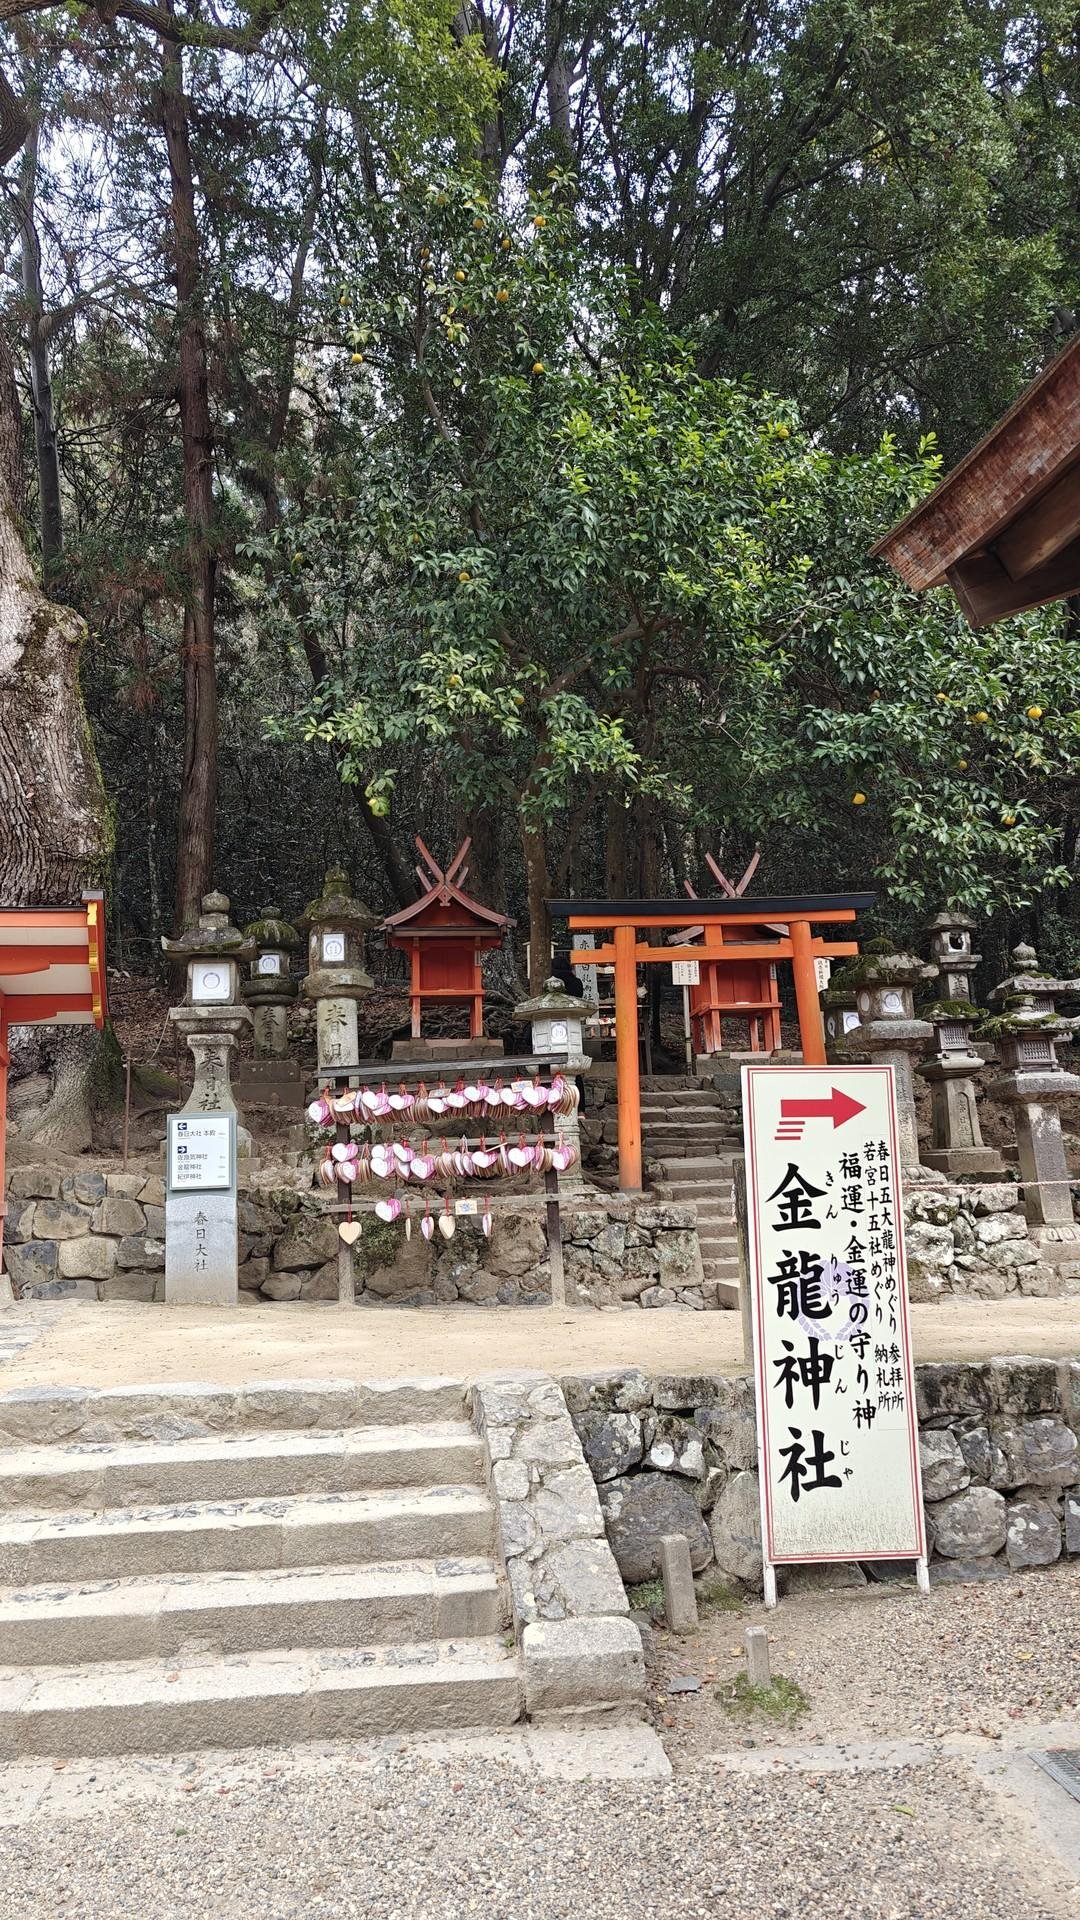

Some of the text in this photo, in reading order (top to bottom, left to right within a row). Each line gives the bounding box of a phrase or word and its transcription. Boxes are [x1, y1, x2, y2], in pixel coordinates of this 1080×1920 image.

[198, 1048, 224, 1112] 春日社
[194, 1210, 208, 1273] 春日大社
[765, 1162, 843, 1503] 金龍神社
[838, 1151, 877, 1430] 福運・金運の守り神
[863, 1141, 891, 1413] 若宮十五社めぐり 納札所
[876, 1140, 904, 1412] 春日五大龍神めぐり 参拝所
